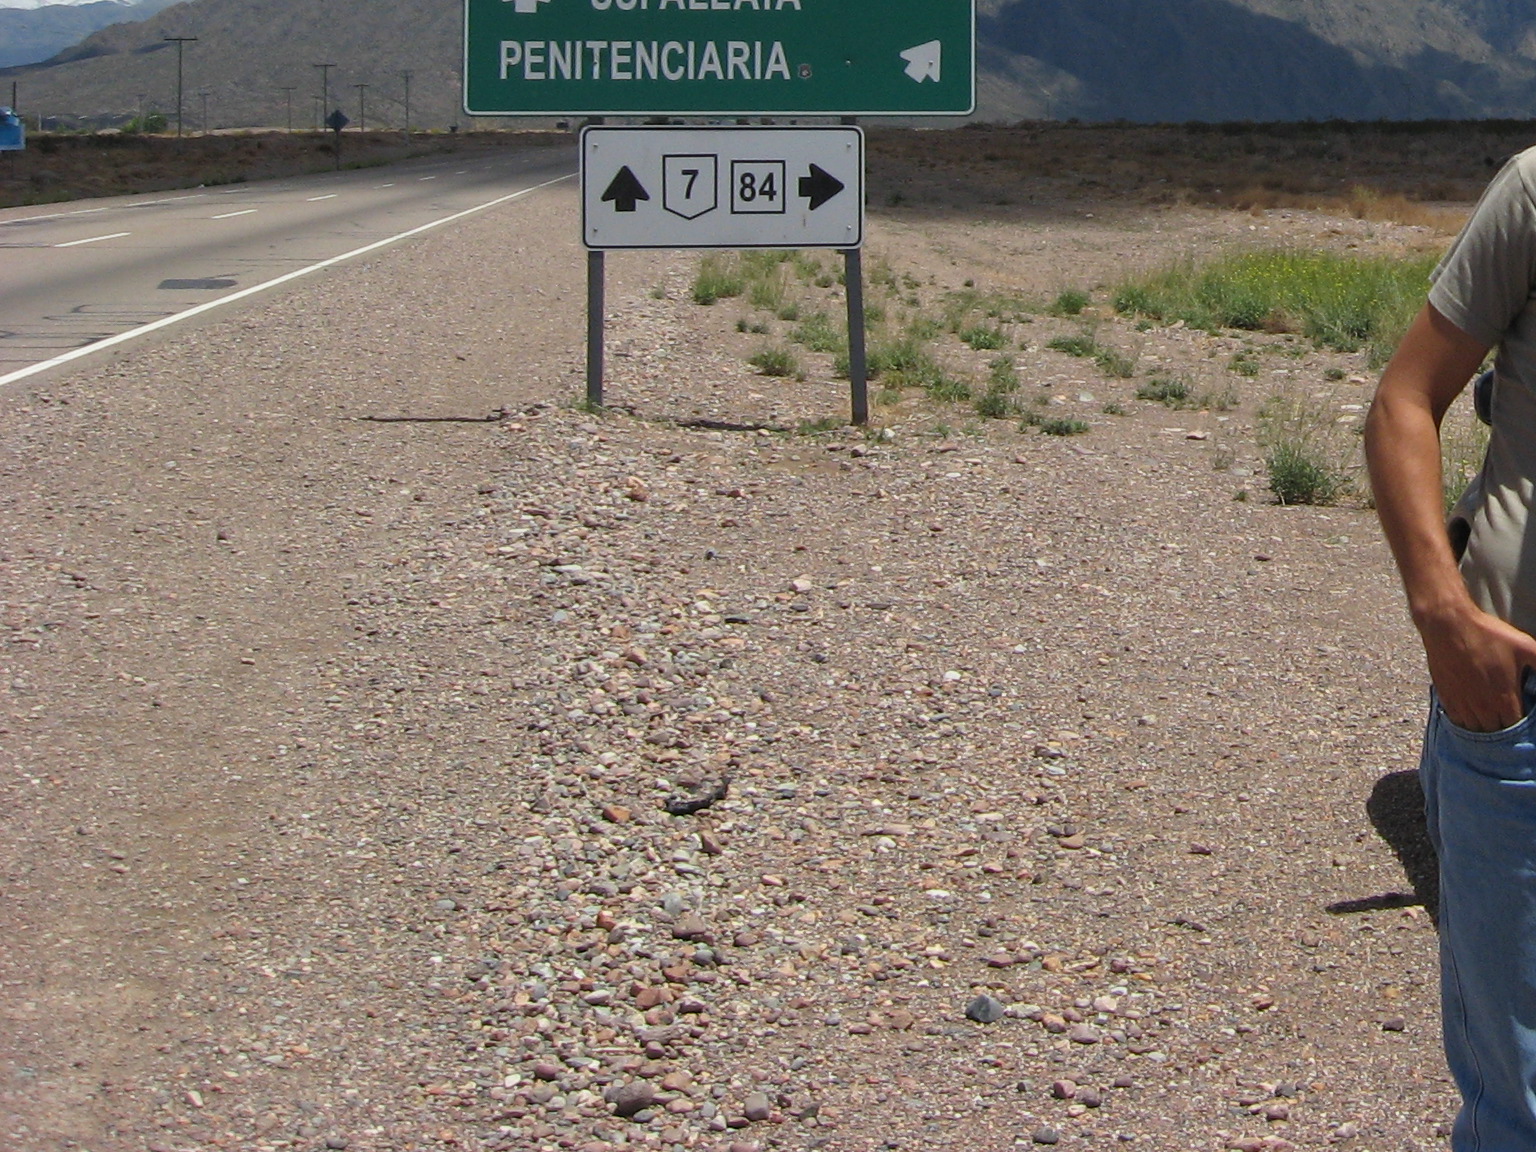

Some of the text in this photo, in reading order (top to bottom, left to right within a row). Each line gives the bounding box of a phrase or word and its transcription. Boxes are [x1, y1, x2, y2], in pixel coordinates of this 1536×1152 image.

[499, 40, 791, 80] PENITENCIARIA
[681, 169, 777, 202] 7 84
